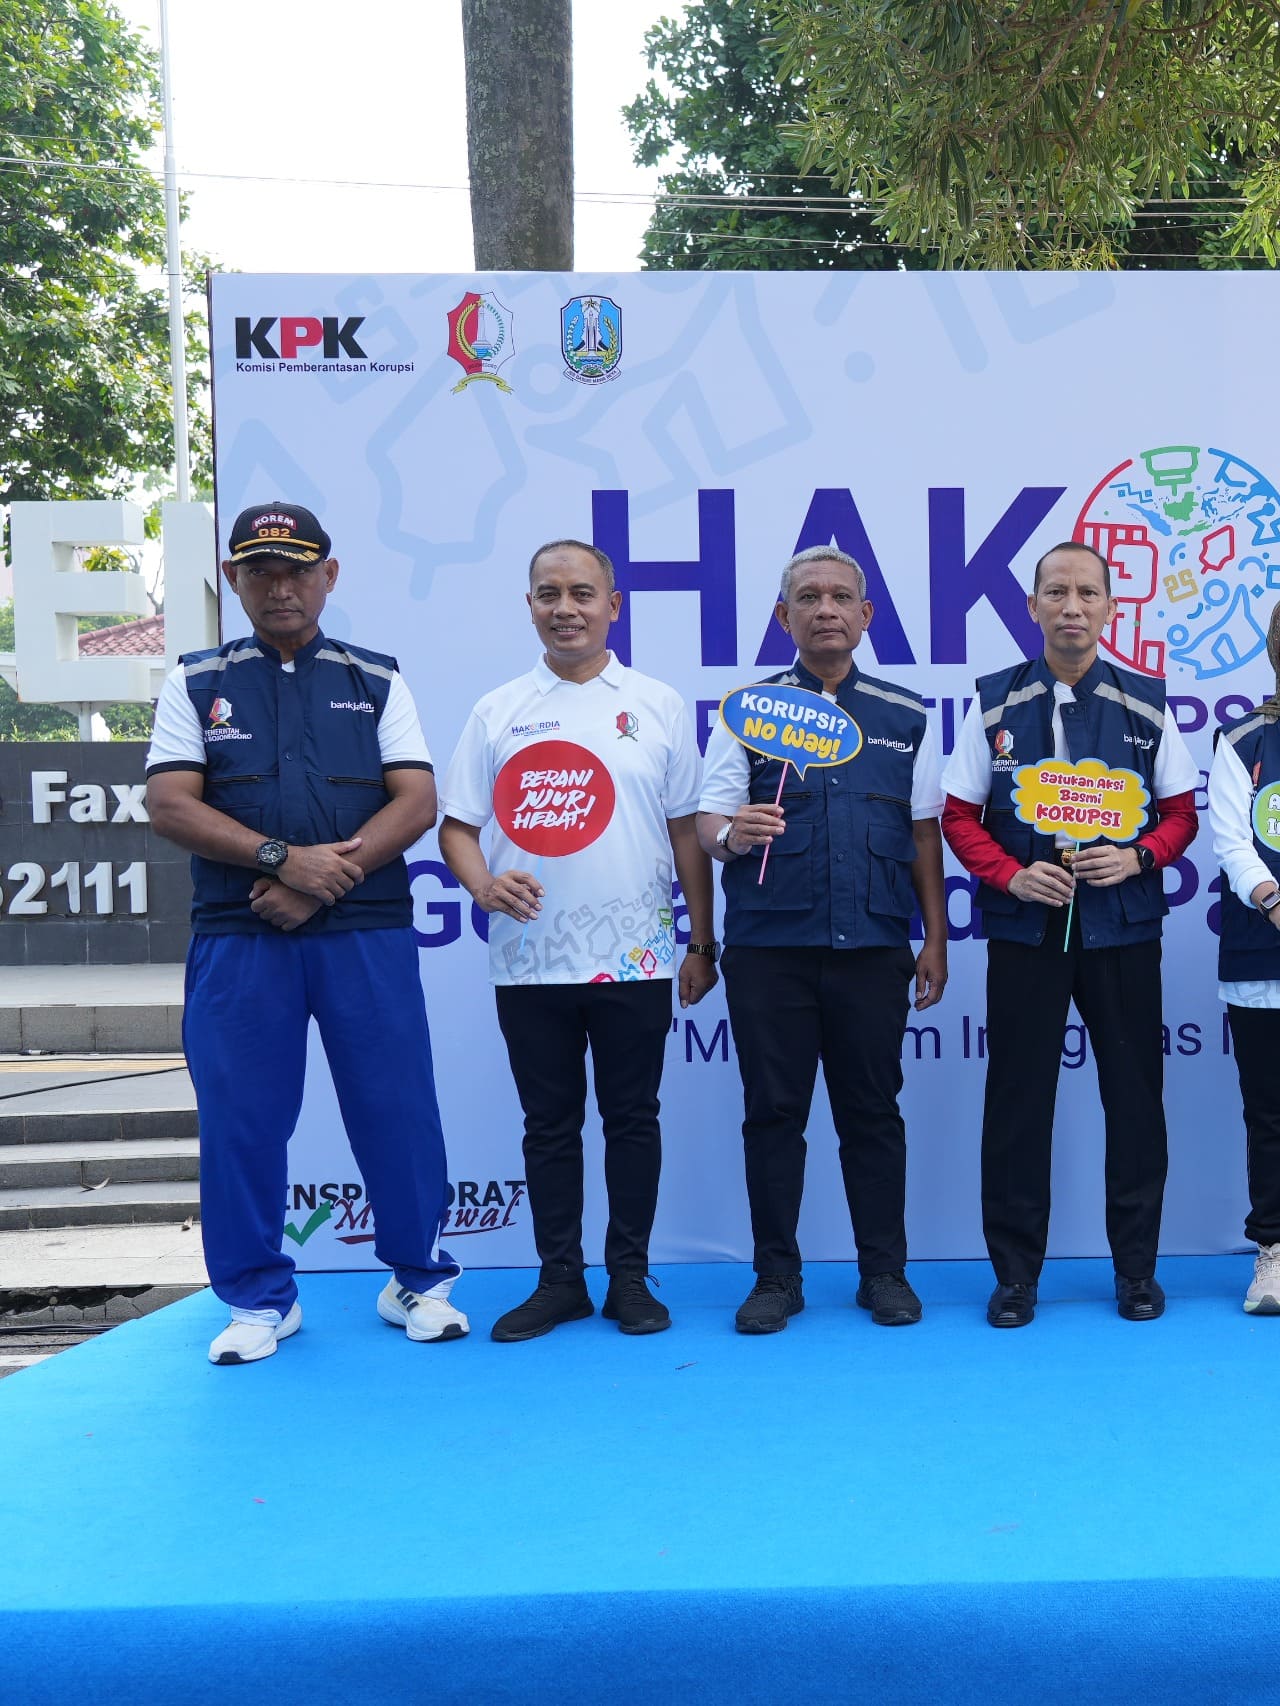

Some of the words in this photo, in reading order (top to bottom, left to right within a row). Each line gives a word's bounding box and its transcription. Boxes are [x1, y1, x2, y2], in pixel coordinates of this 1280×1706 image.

[235, 317, 368, 359] KPK
[236, 362, 275, 373] Komisi
[279, 362, 367, 373] Pemberantasan
[370, 362, 415, 374] Korupsi
[254, 514, 294, 528] KOREM
[258, 527, 291, 538] 082
[740, 691, 848, 735] KORUPSI?
[743, 717, 777, 741] No
[781, 723, 842, 761] Way!
[520, 768, 594, 790] BERANI
[1040, 771, 1094, 788] Satukan
[1096, 778, 1125, 791] Aksi
[1059, 789, 1103, 804] Basmi
[1036, 803, 1122, 829] KORUPSI
[0, 861, 148, 914] 2111
